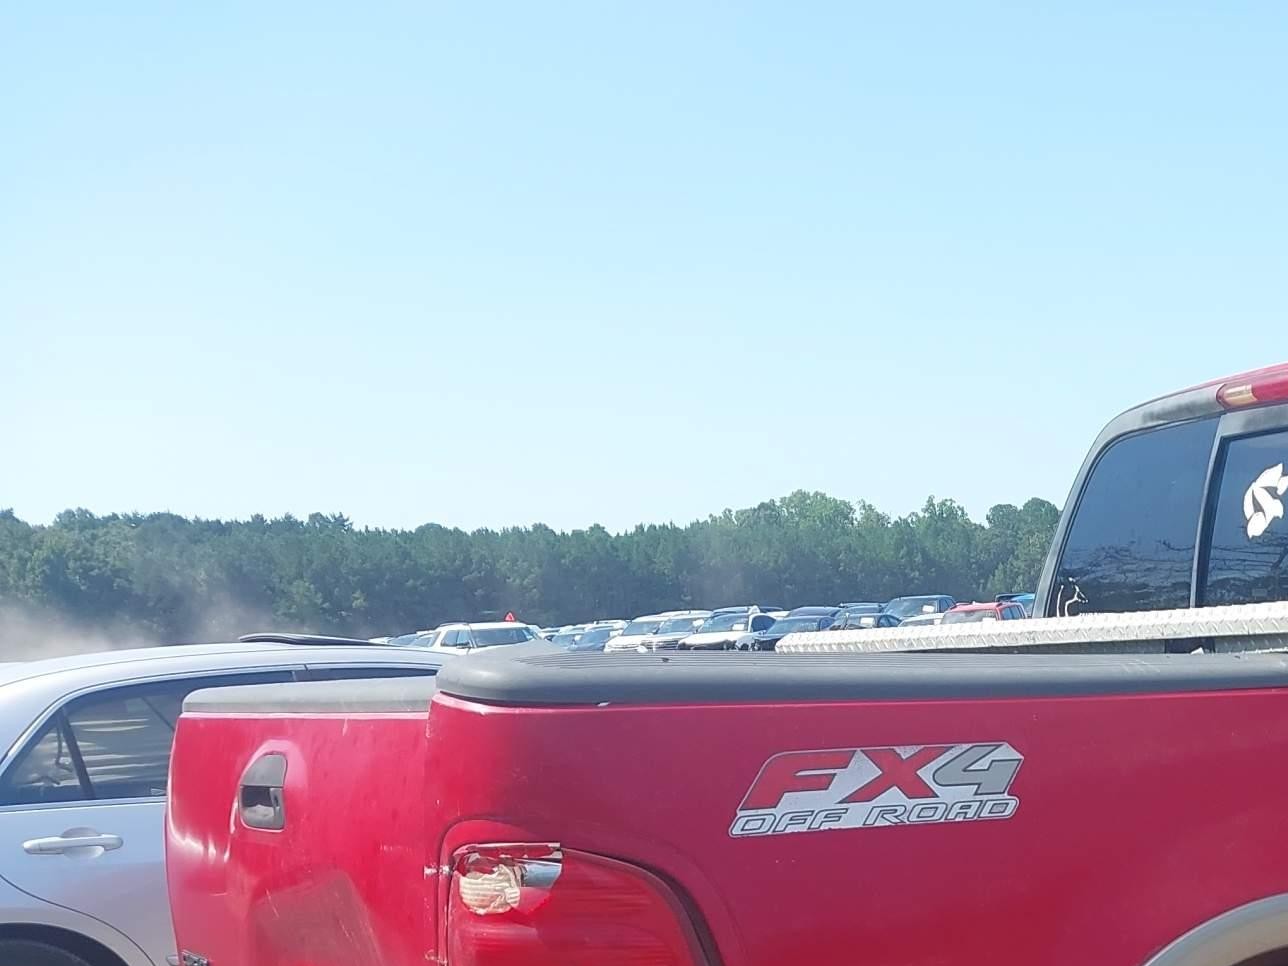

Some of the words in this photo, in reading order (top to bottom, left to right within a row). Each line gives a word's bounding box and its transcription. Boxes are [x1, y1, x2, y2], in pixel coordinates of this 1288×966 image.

[738, 742, 1024, 811] FX4
[731, 806, 848, 836] OFF
[863, 797, 1020, 827] ROAD
